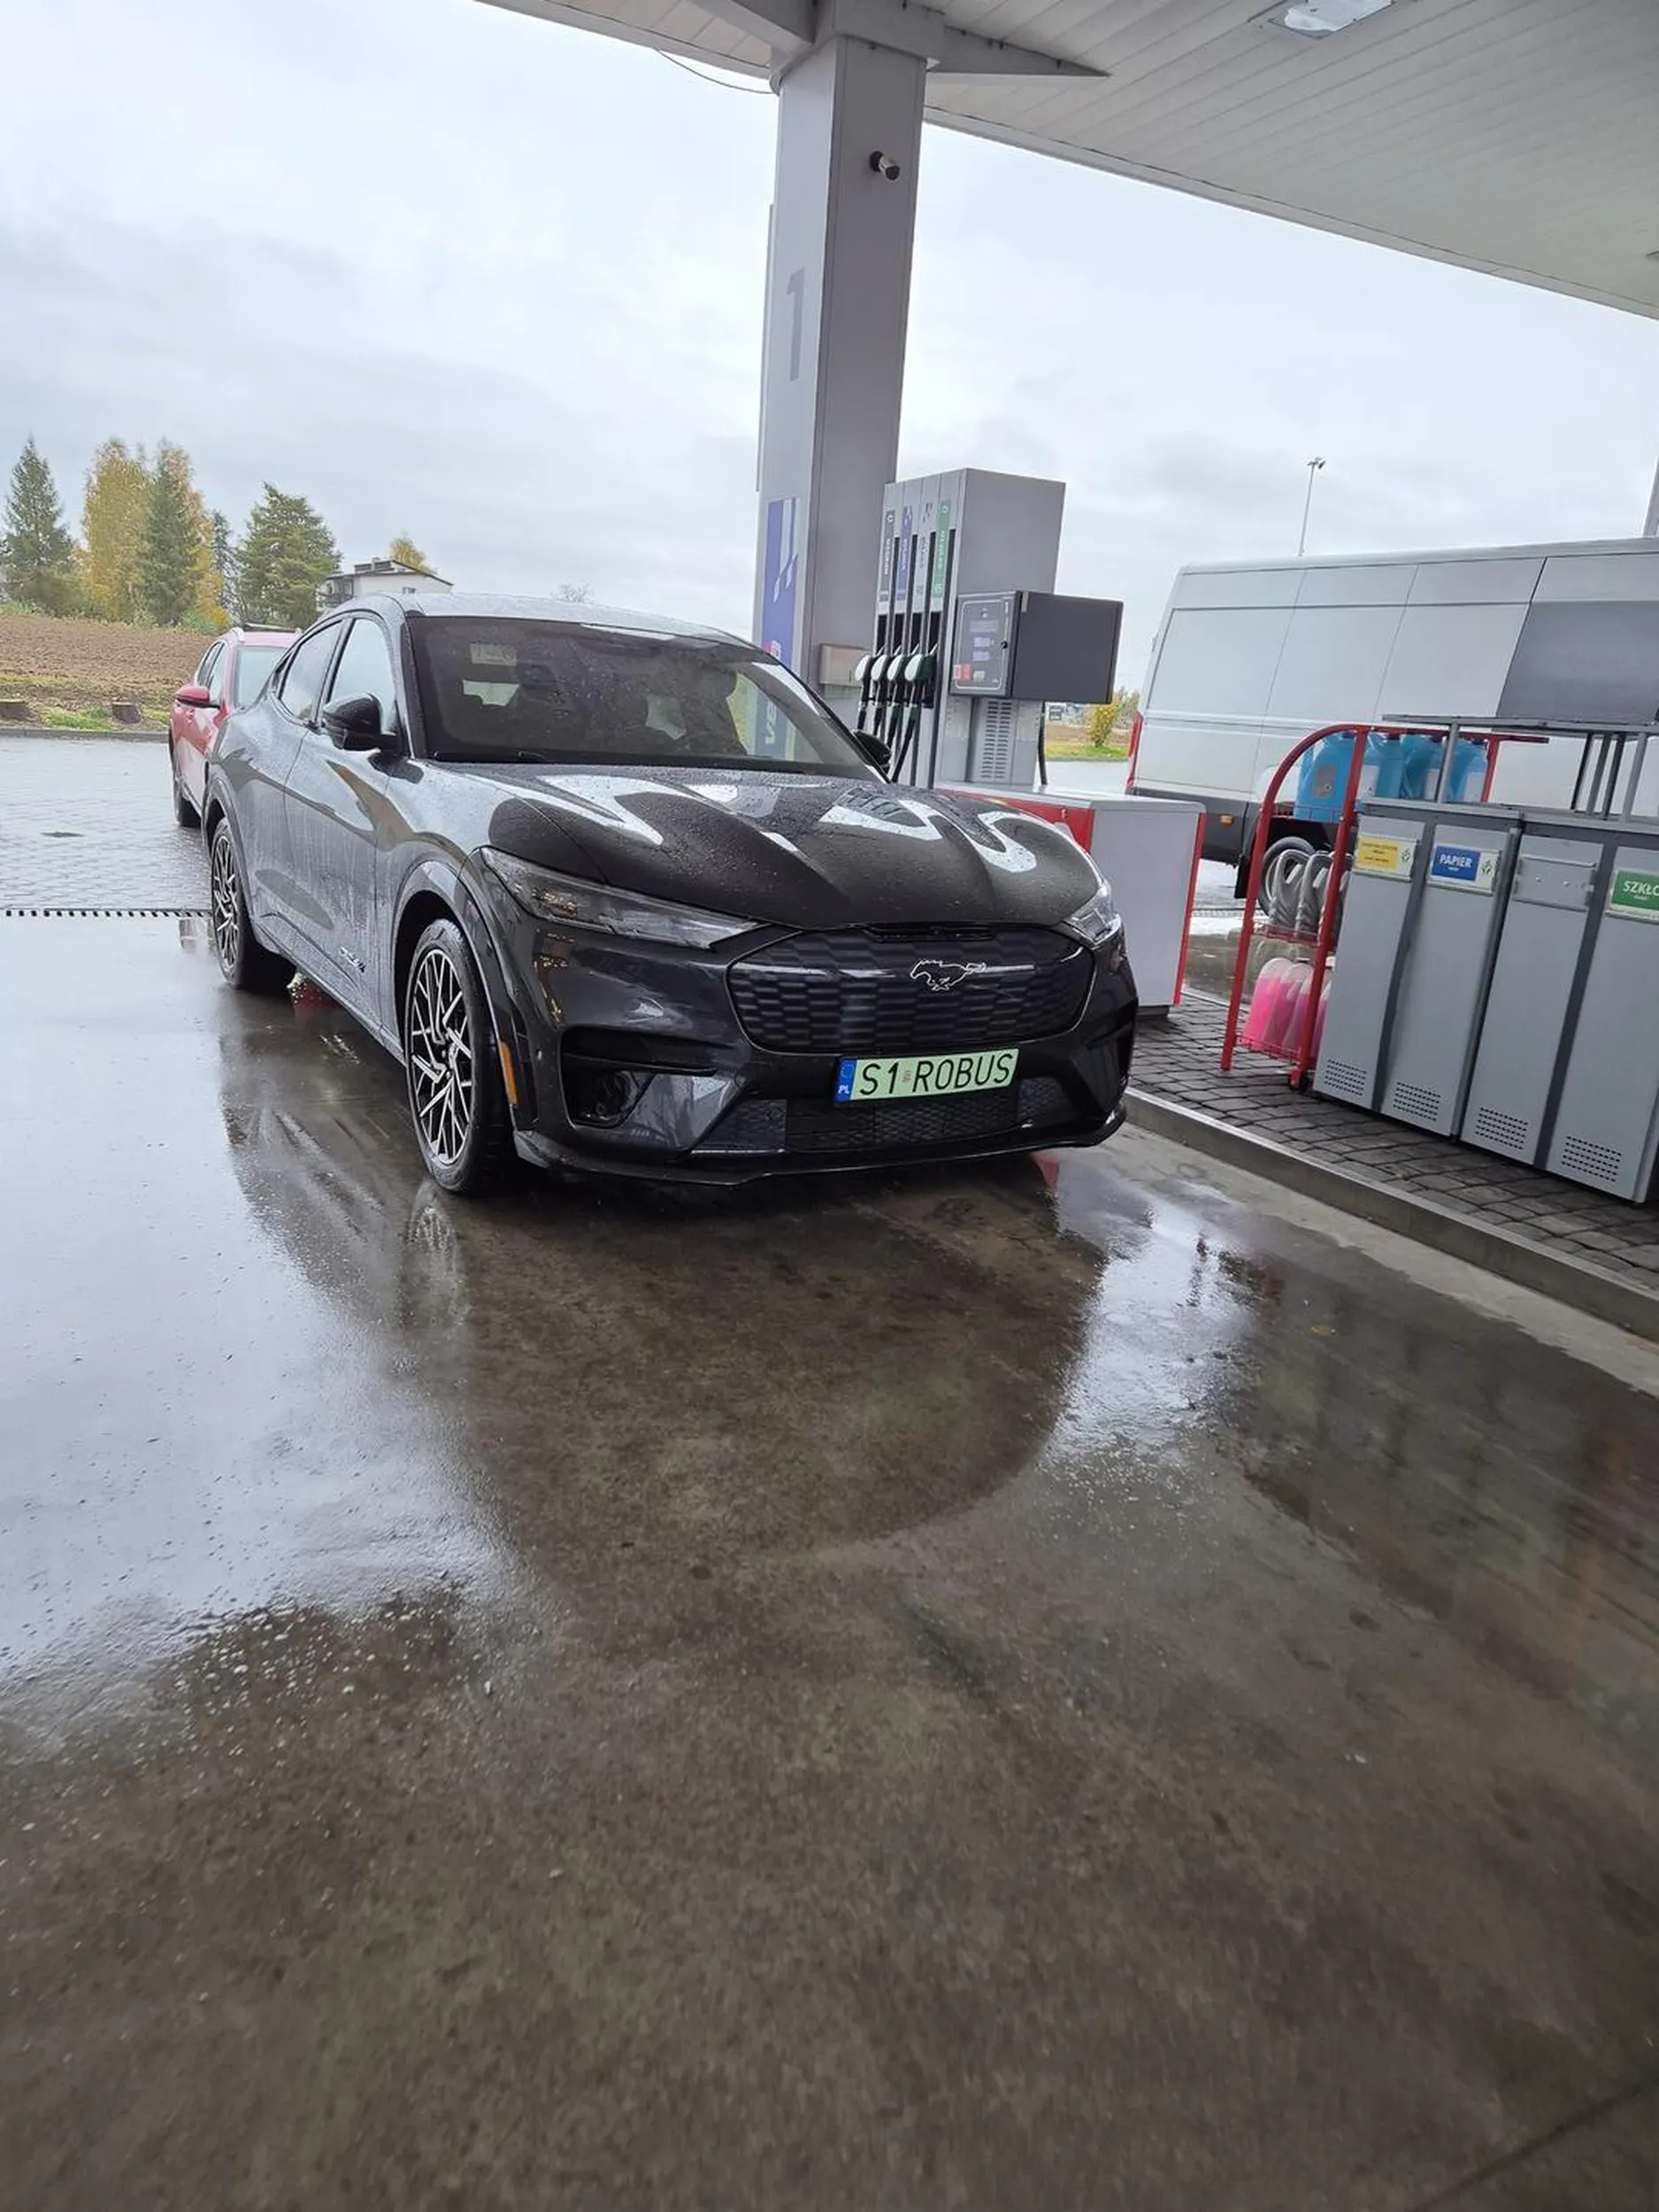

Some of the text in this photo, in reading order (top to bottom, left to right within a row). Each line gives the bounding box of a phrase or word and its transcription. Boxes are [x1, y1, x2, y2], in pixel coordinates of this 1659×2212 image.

[787, 267, 805, 381] 1
[1439, 854, 1473, 869] PAPIER
[859, 1053, 1013, 1095] S1 ROBUS
[838, 1085, 850, 1094] PL
